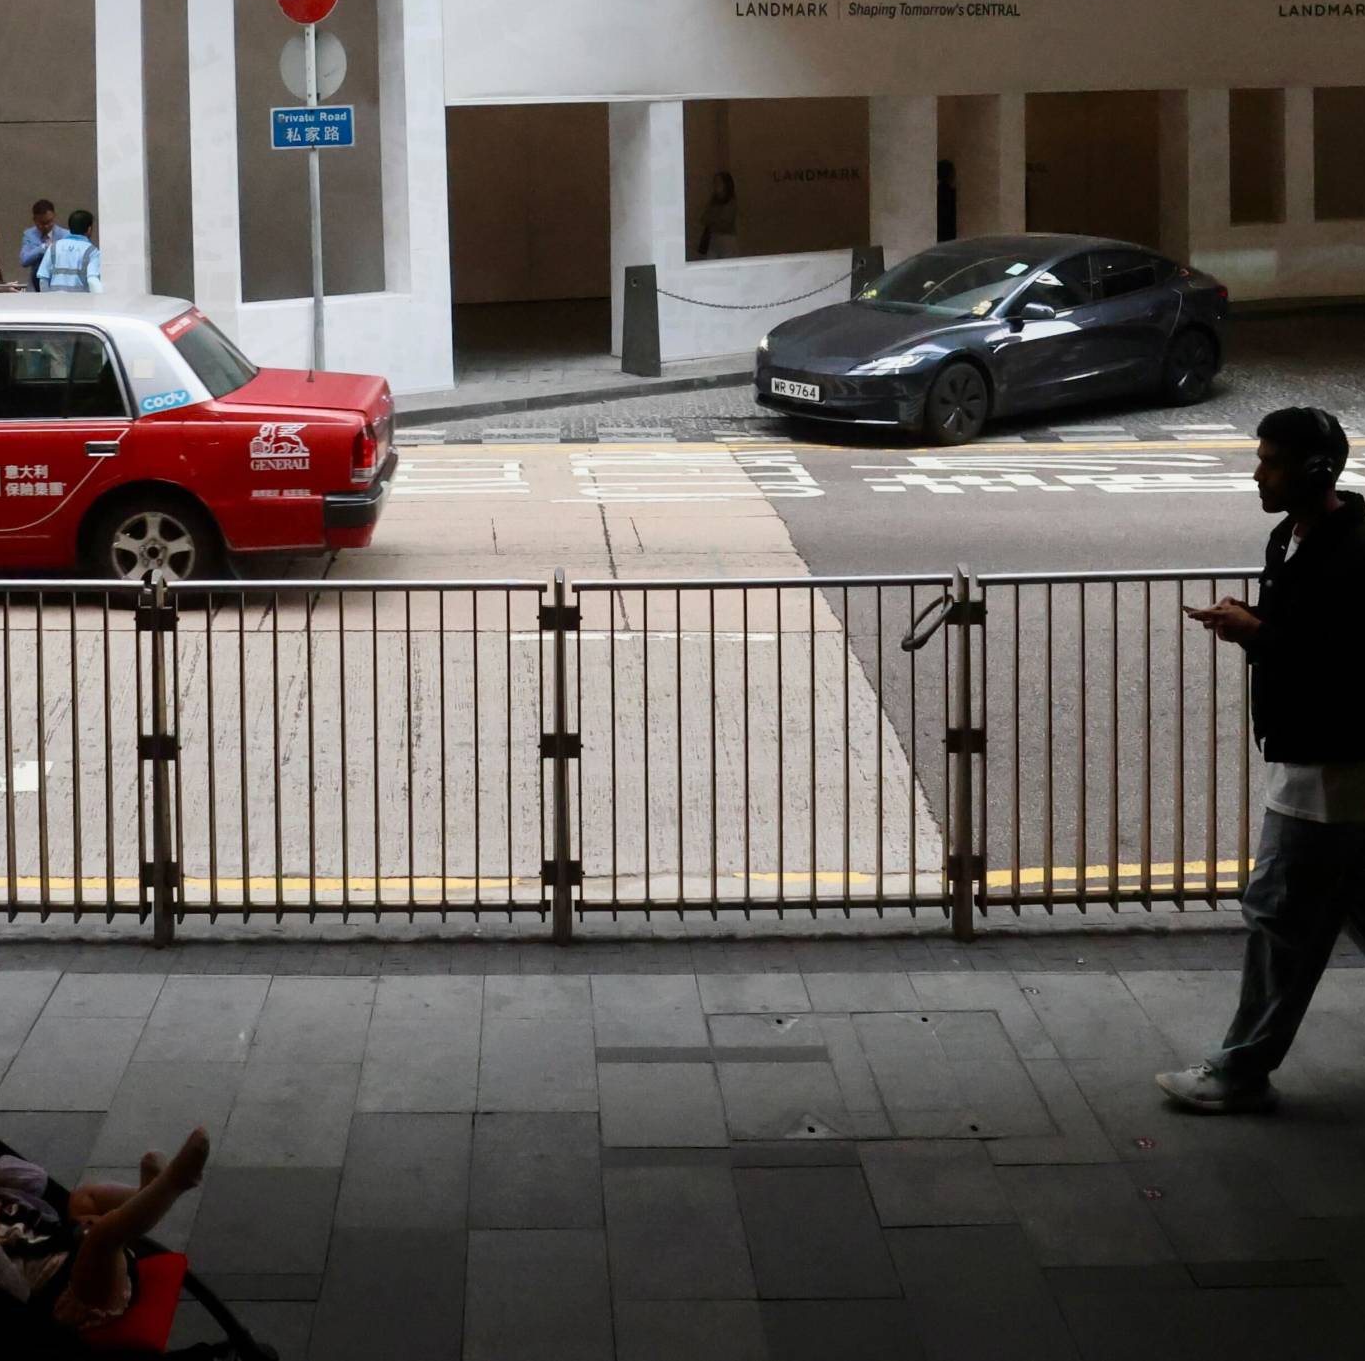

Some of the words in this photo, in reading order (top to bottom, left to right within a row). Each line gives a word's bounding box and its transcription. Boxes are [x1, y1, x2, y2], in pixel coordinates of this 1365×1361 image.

[735, 2, 828, 17] LANDMARK
[848, 1, 896, 19] Shaping
[899, 1, 965, 17] Tomorrow's
[966, 2, 1021, 17] CENTRAL
[278, 112, 315, 123] Private
[319, 111, 347, 122] Road
[286, 125, 340, 143] 私家路
[773, 167, 860, 182] LANDMARK
[789, 383, 817, 399] 9764
[4, 464, 49, 480] 意大利
[250, 458, 311, 471] GENERALI
